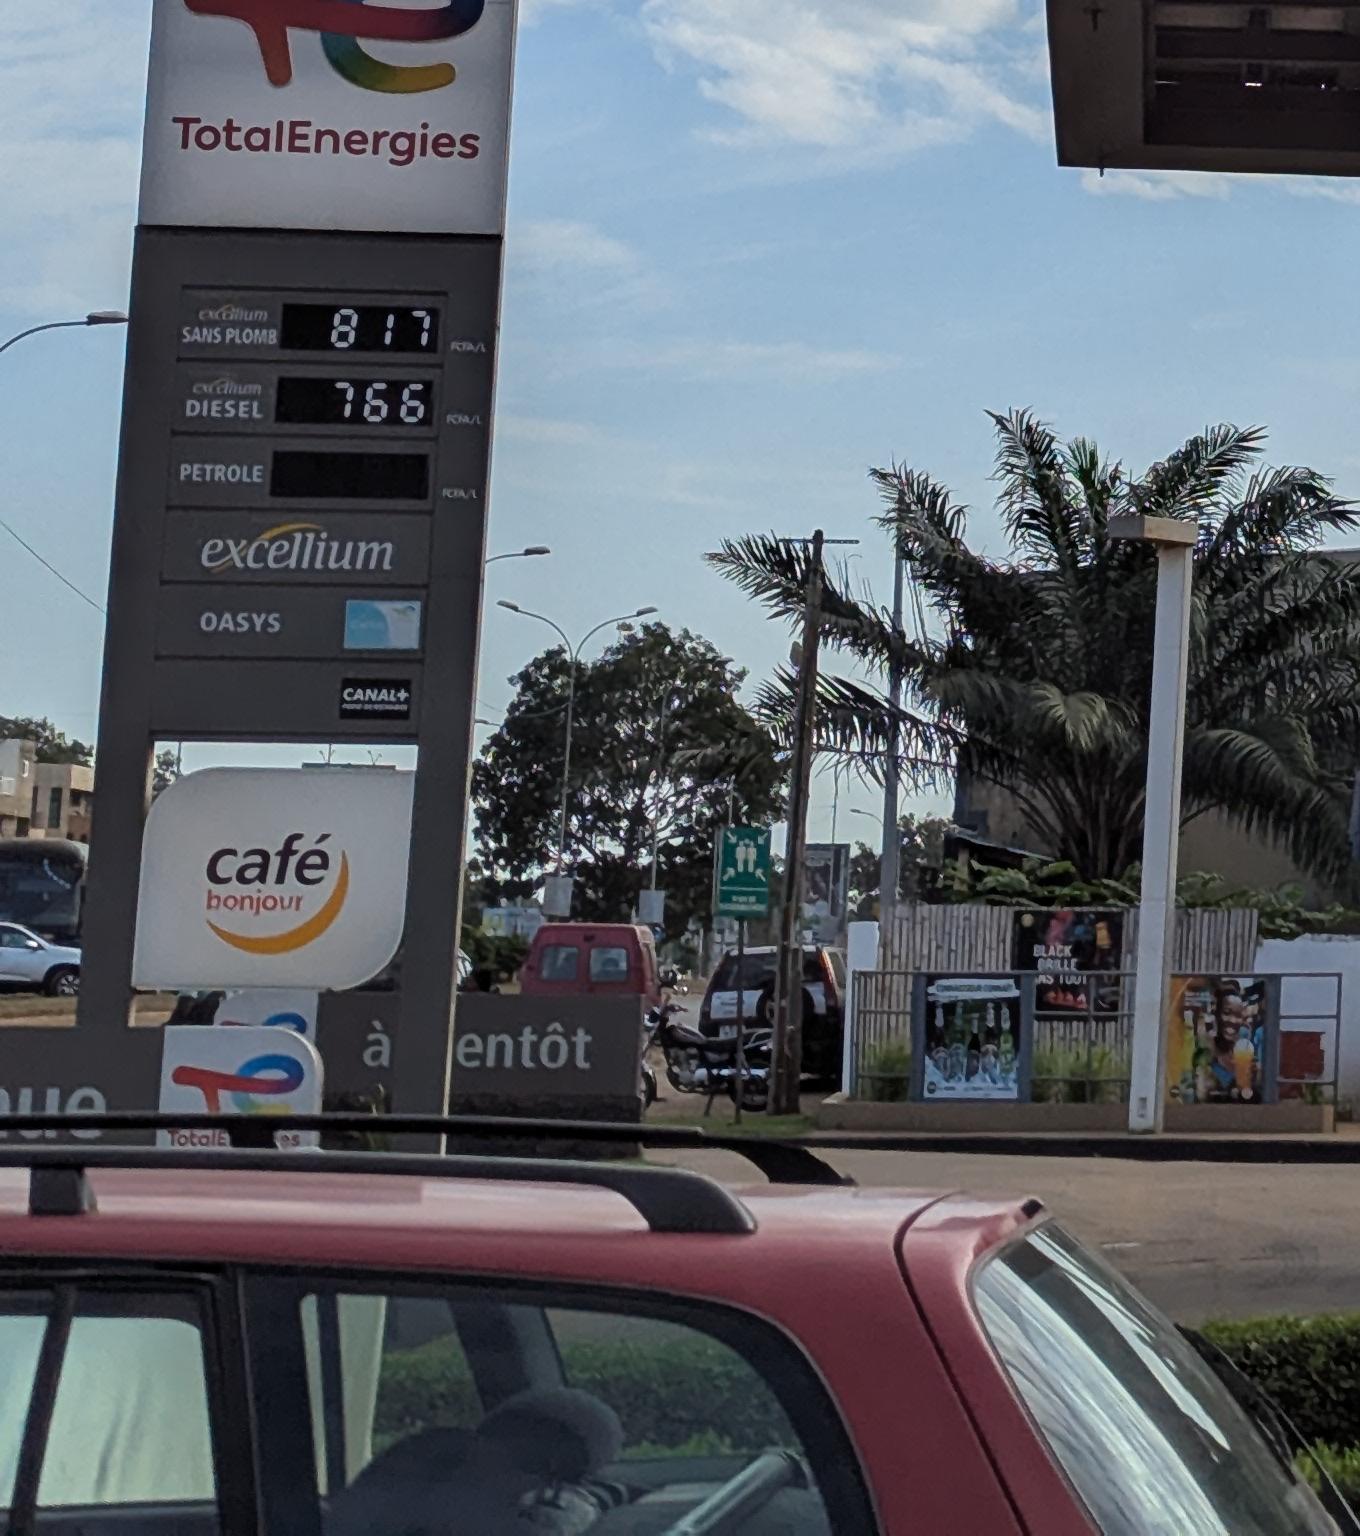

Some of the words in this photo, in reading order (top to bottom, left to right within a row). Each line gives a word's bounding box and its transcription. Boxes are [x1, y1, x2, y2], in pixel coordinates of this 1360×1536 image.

[172, 116, 480, 166] TotalEnergies
[182, 326, 222, 344] SANS
[225, 327, 278, 345] PLOMB
[330, 308, 431, 348] 817
[185, 399, 263, 419] DIESEL
[334, 381, 425, 423] 766
[180, 463, 264, 483] PETROLE
[201, 531, 393, 571] excellium
[200, 611, 281, 633] OASYS
[342, 687, 409, 702] CANAL+
[206, 832, 332, 886] café
[206, 888, 303, 916] bonjour
[1033, 944, 1073, 957] BLACK
[363, 1020, 391, 1067] à
[456, 1022, 593, 1069] entôt
[168, 1128, 300, 1147] TotalEes
